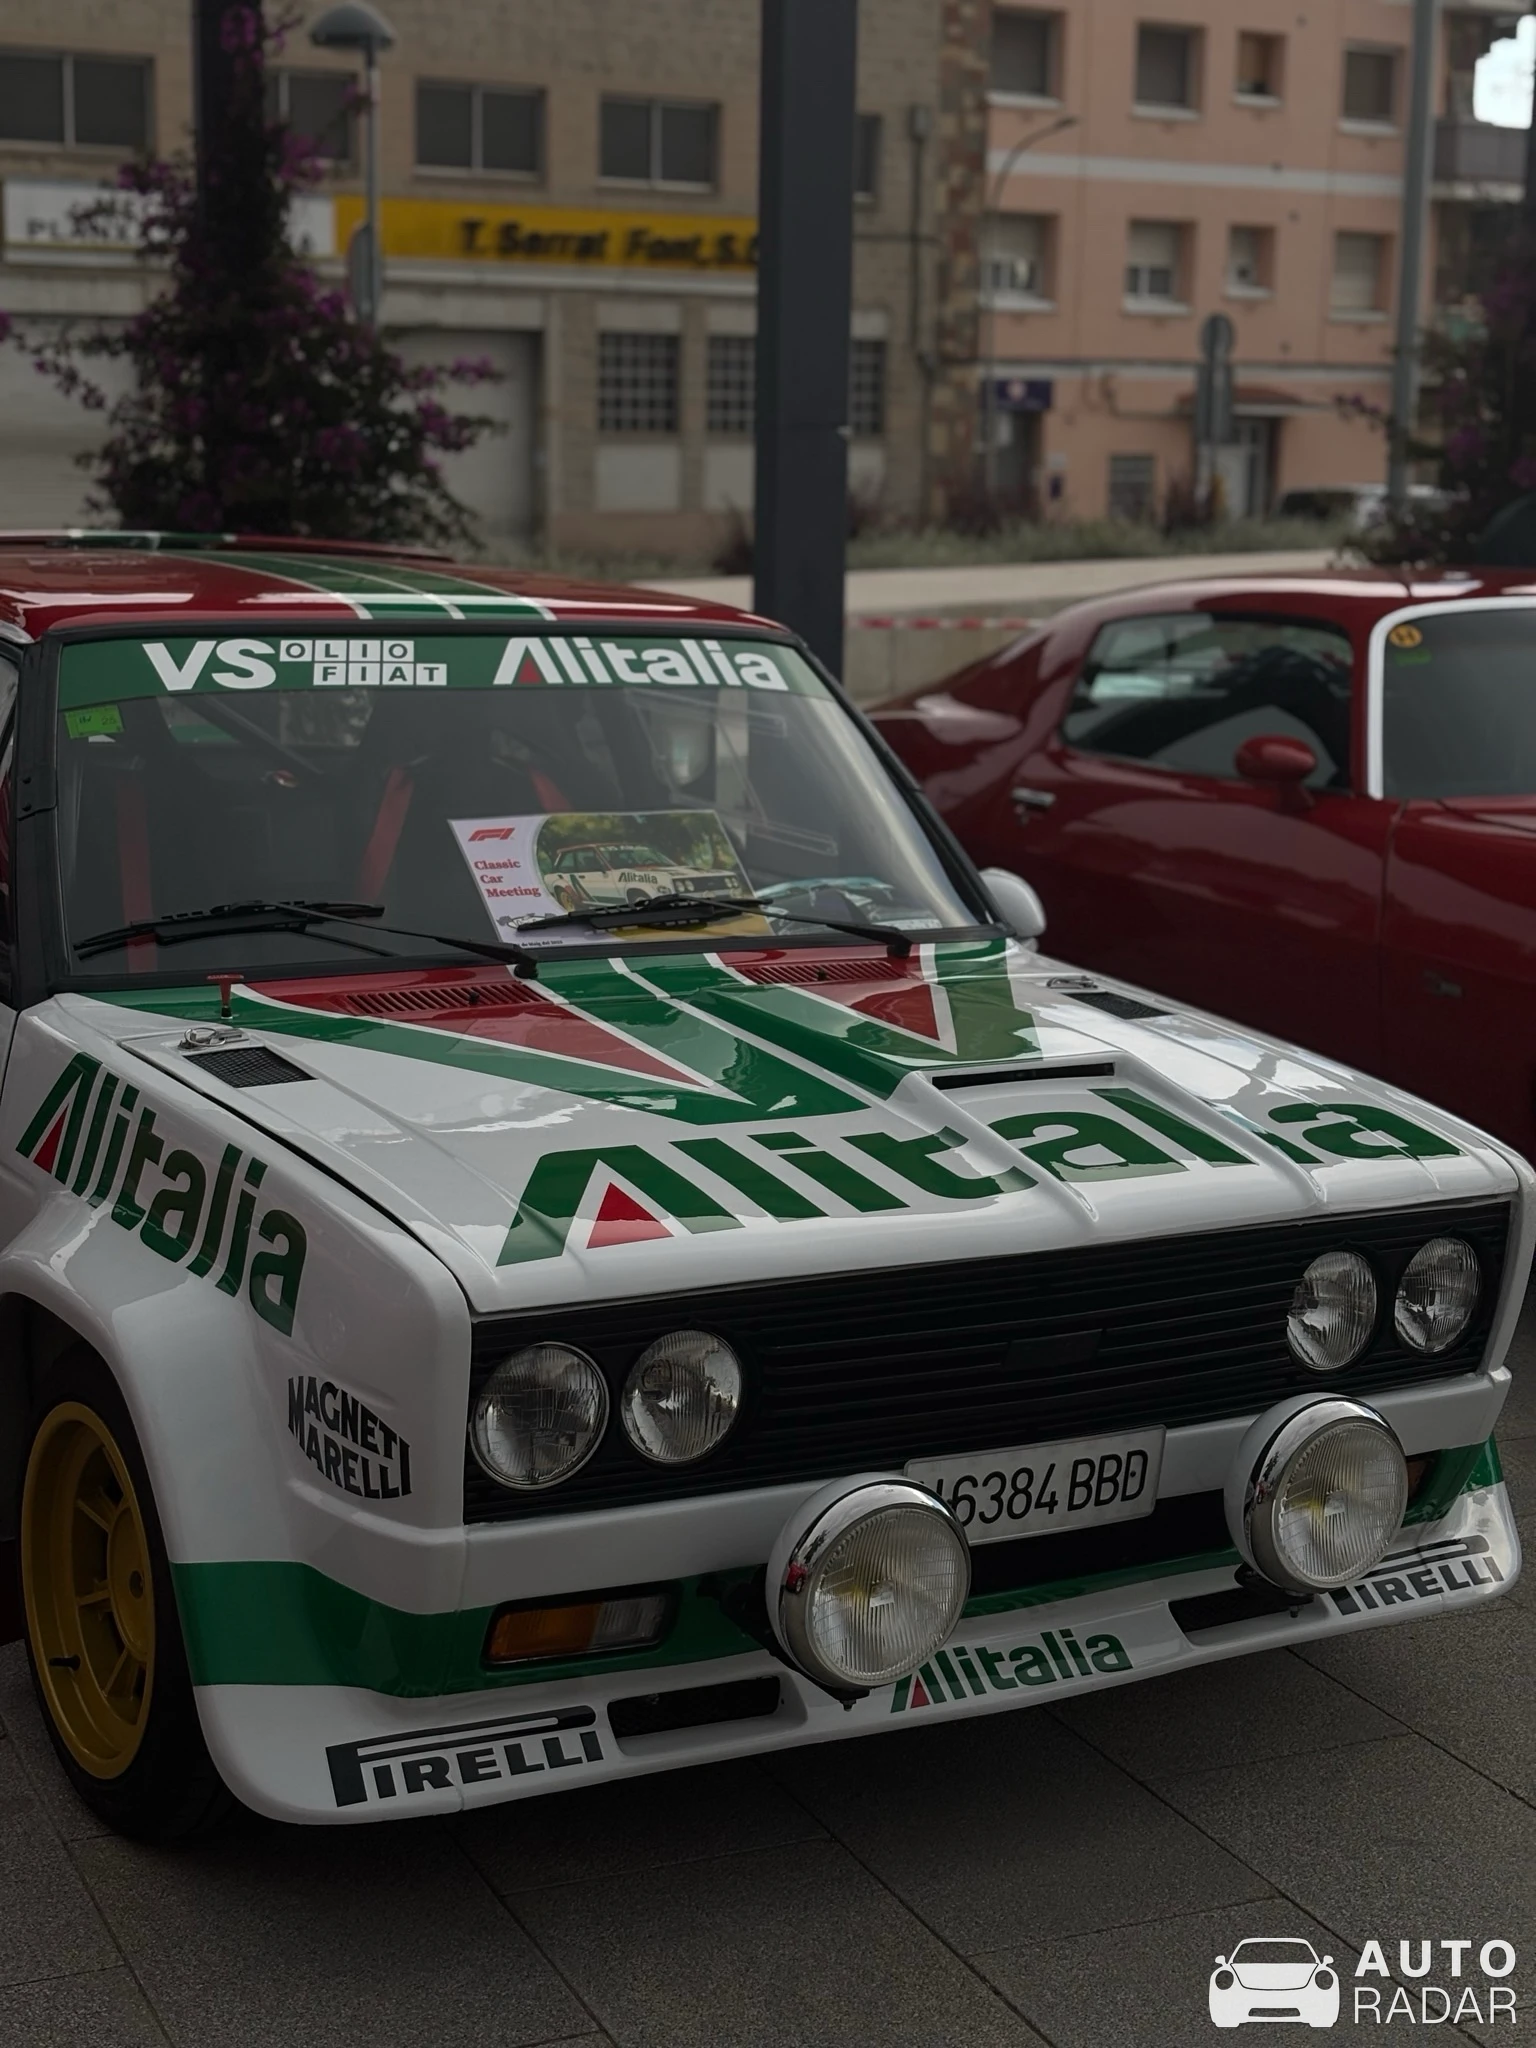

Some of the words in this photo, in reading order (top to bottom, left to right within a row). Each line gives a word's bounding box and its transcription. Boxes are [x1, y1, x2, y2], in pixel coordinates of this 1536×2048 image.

[142, 638, 276, 691] VS
[493, 636, 789, 691] Alitalia
[474, 859, 521, 870] Classic
[480, 875, 503, 884] Car
[618, 872, 657, 884] Alitalia
[485, 887, 541, 898] Meeting
[15, 1051, 308, 1338] Alitalia
[288, 1375, 410, 1494] MAGNETI
[288, 1400, 412, 1499] MARELLI
[890, 1628, 1133, 1714] Alitalia
[325, 1705, 604, 1807] PIRELLI
